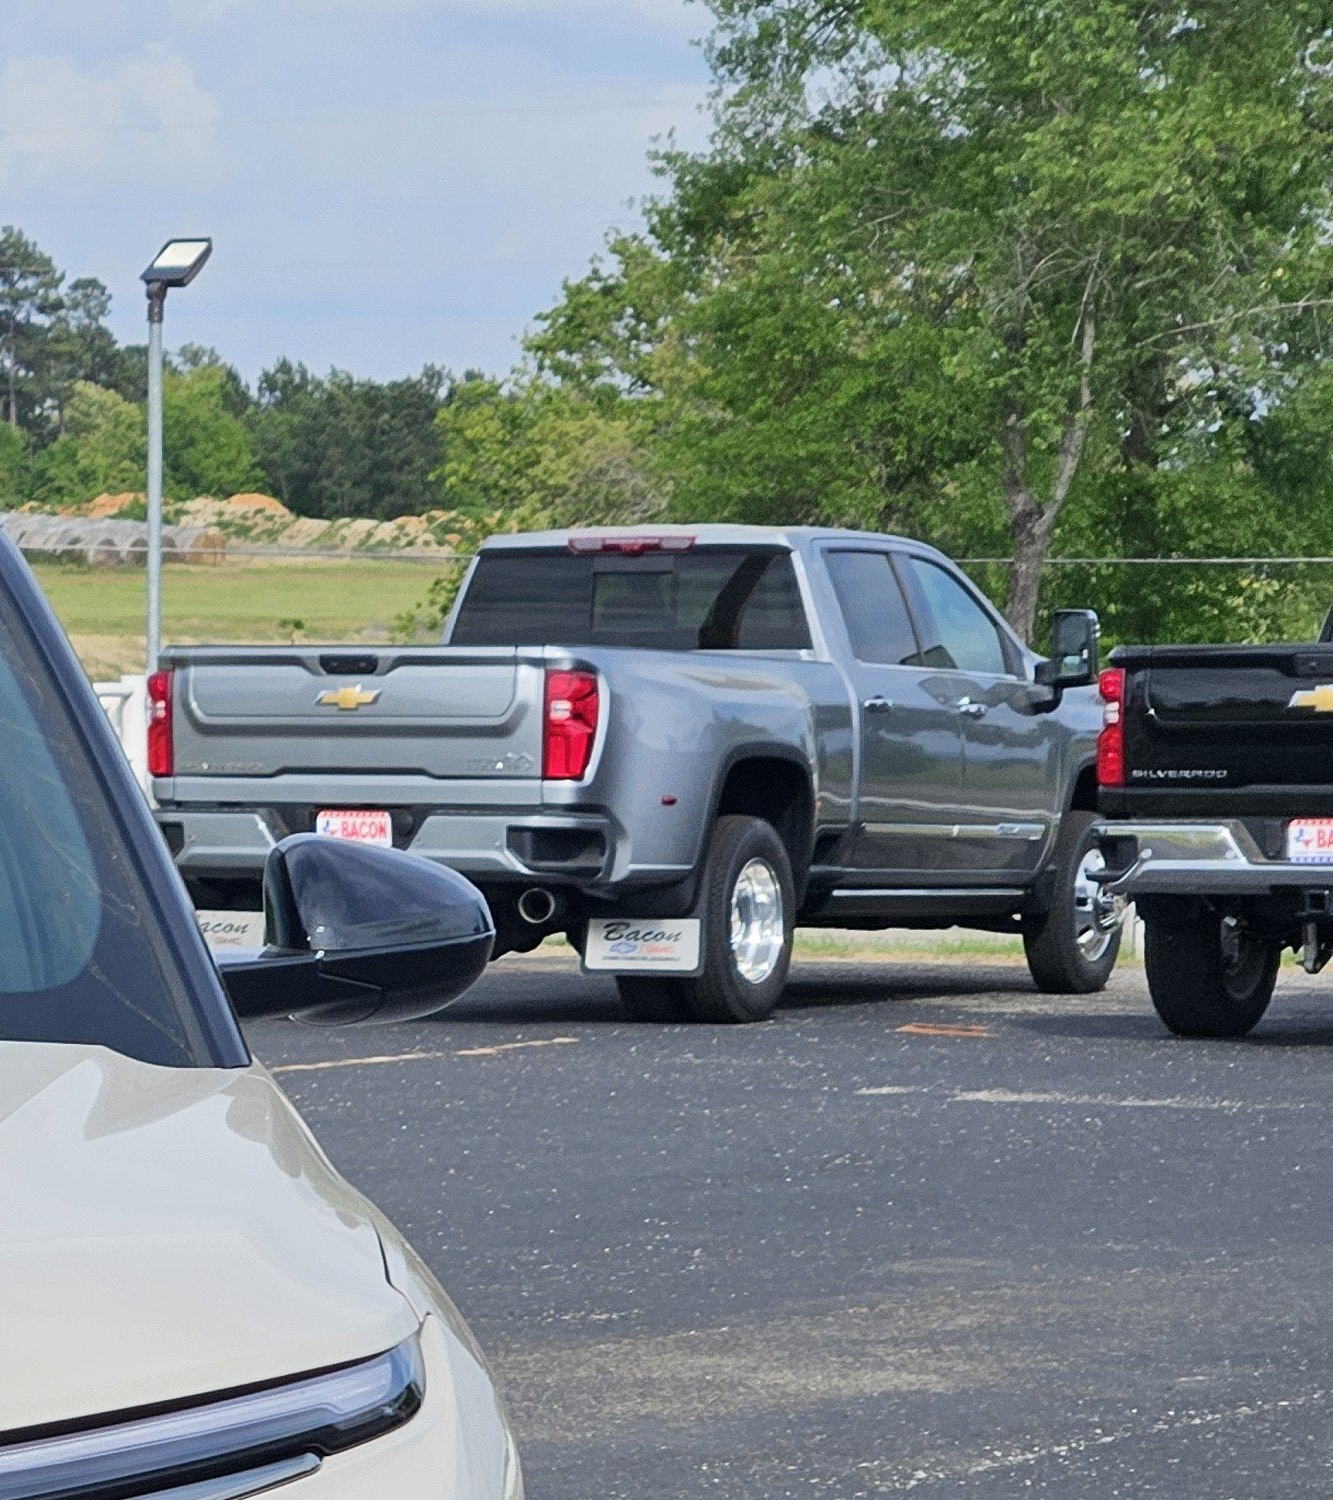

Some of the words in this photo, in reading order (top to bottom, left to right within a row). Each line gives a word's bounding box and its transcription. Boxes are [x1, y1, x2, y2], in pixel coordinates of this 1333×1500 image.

[1132, 769, 1228, 779] SILVERADO
[341, 821, 387, 838] BACON
[198, 922, 249, 934] acon
[603, 921, 683, 942] Bacon
